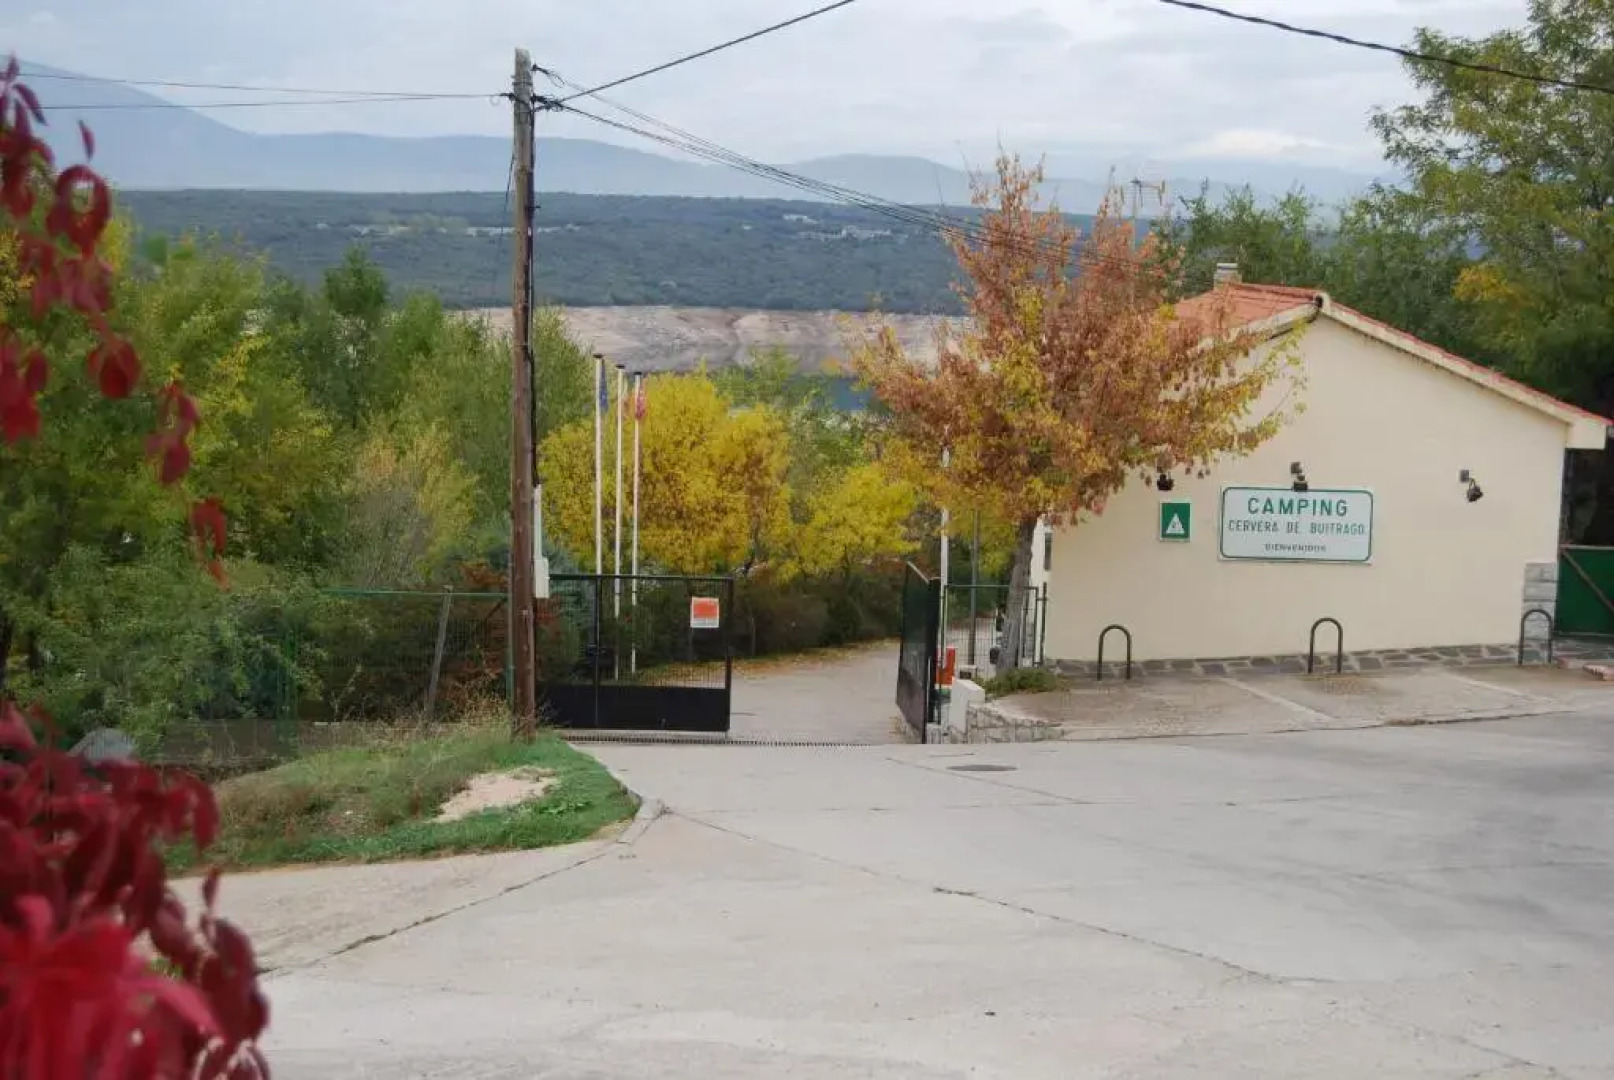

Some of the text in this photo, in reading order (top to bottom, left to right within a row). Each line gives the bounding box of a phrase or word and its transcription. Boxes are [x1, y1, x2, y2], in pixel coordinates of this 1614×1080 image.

[1247, 497, 1348, 517] CAMPING
[1228, 520, 1365, 536] CERVERA DE BUITRAGO
